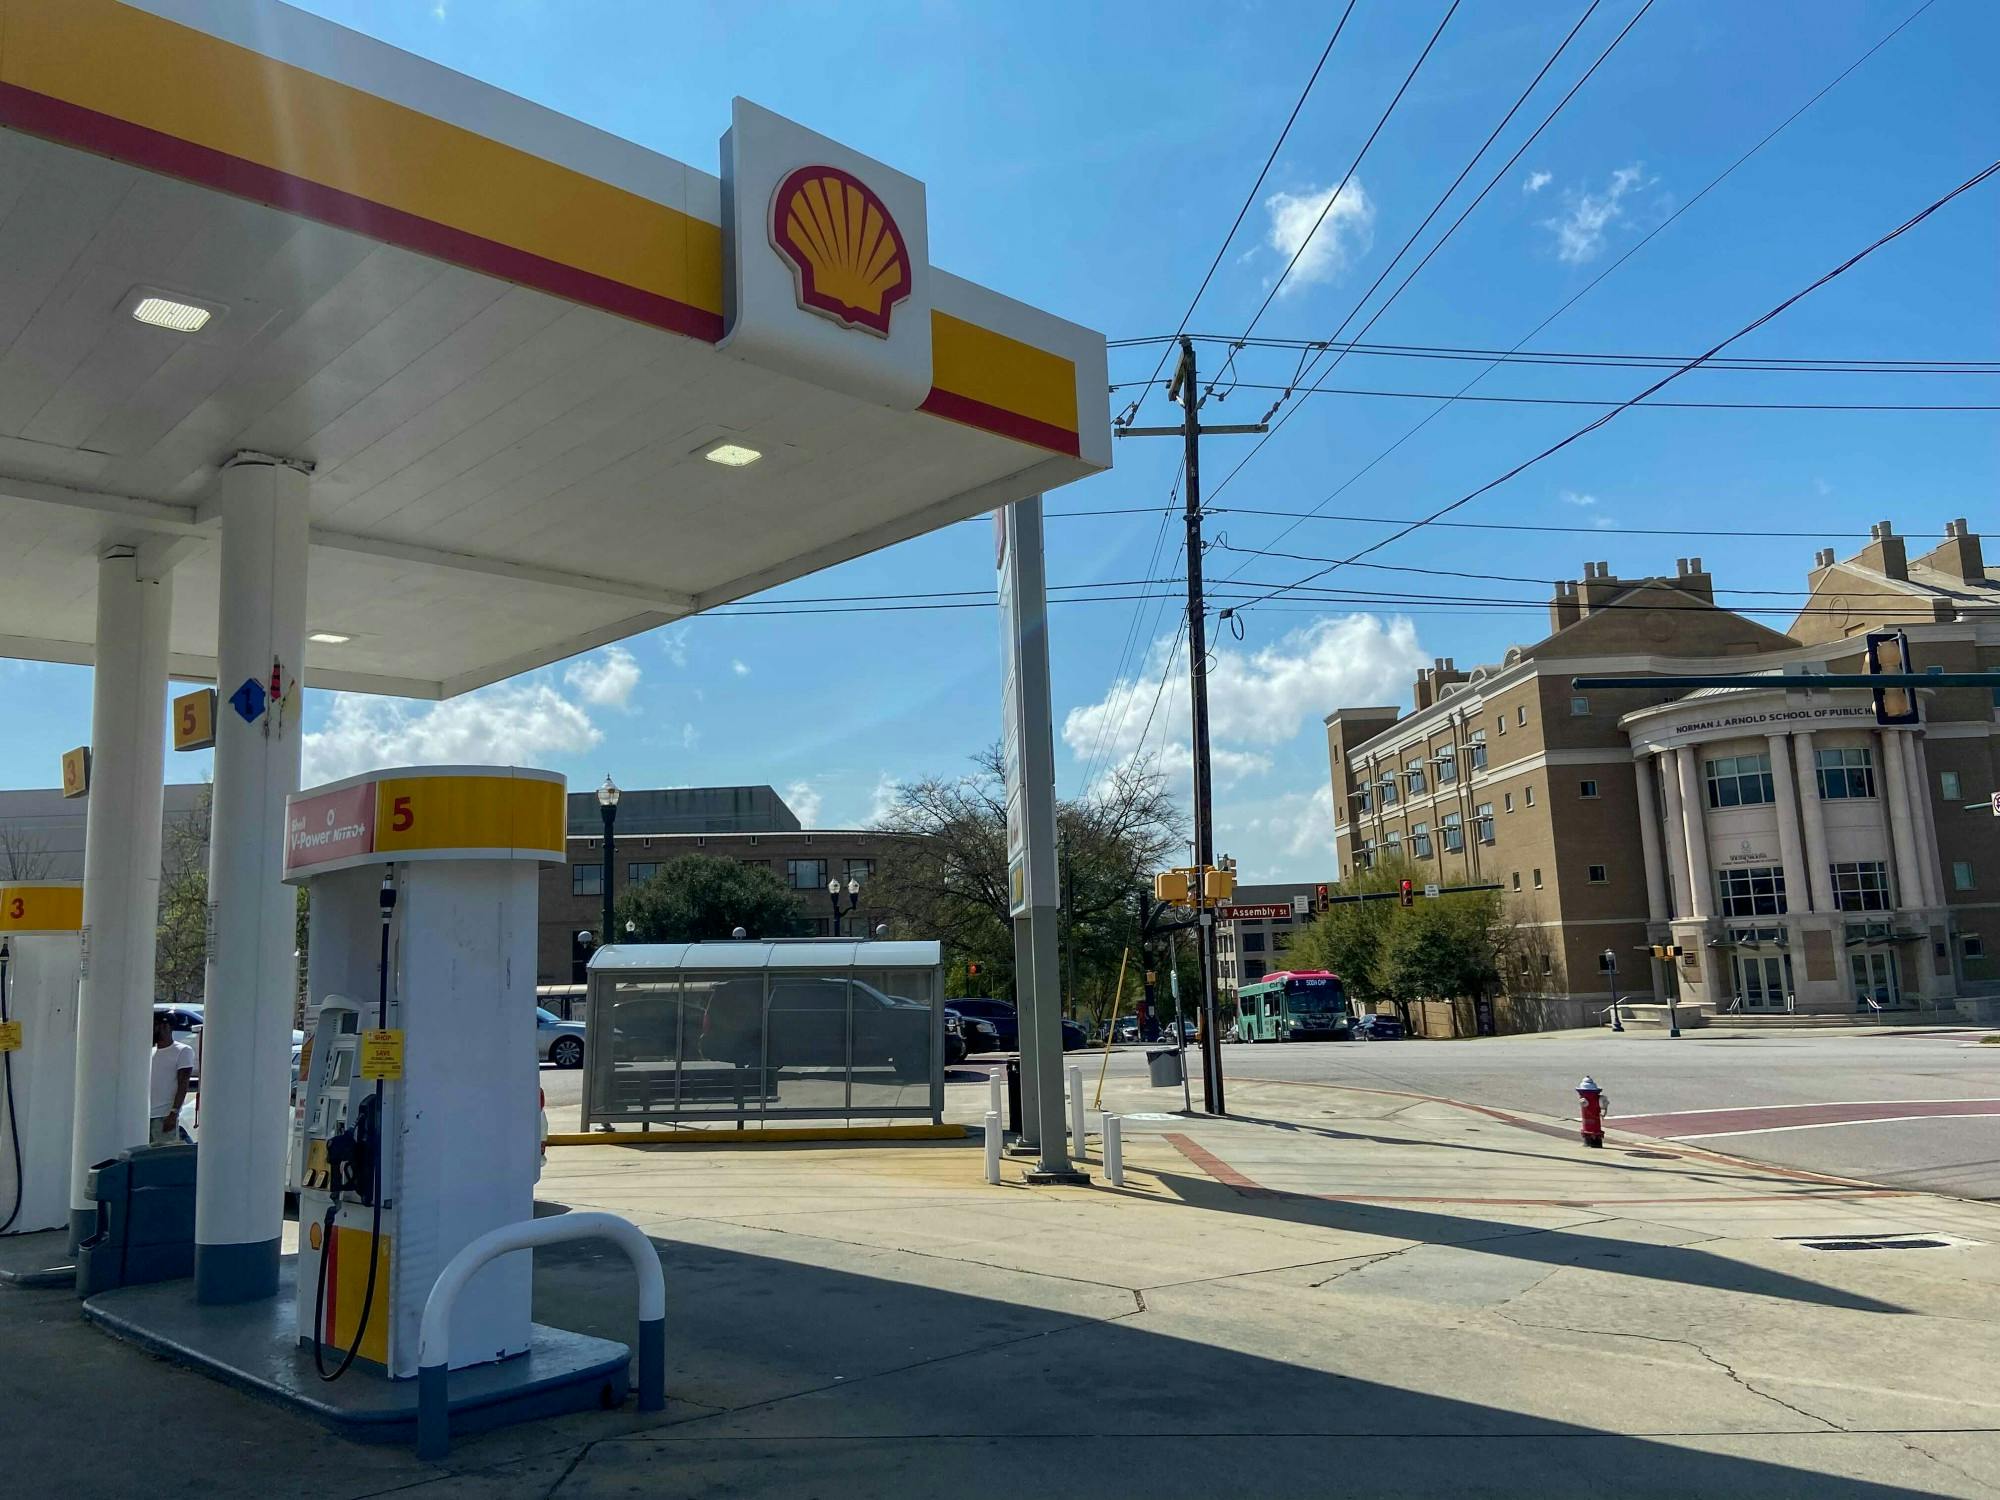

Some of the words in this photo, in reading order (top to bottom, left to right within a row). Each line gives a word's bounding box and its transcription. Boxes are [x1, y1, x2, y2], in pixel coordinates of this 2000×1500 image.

[182, 703, 197, 736] 5
[1676, 721, 1714, 734] NORMAN
[1724, 714, 1767, 726] ARNOLD
[1769, 710, 1812, 721] SCHOOL
[1814, 709, 1828, 717] OF
[1829, 707, 1864, 717] PUBLIC
[66, 759, 77, 786] 3
[392, 796, 414, 832] 5
[291, 830, 331, 851] V-Power
[10, 897, 25, 919] 3
[1232, 907, 1276, 917] Assembly
